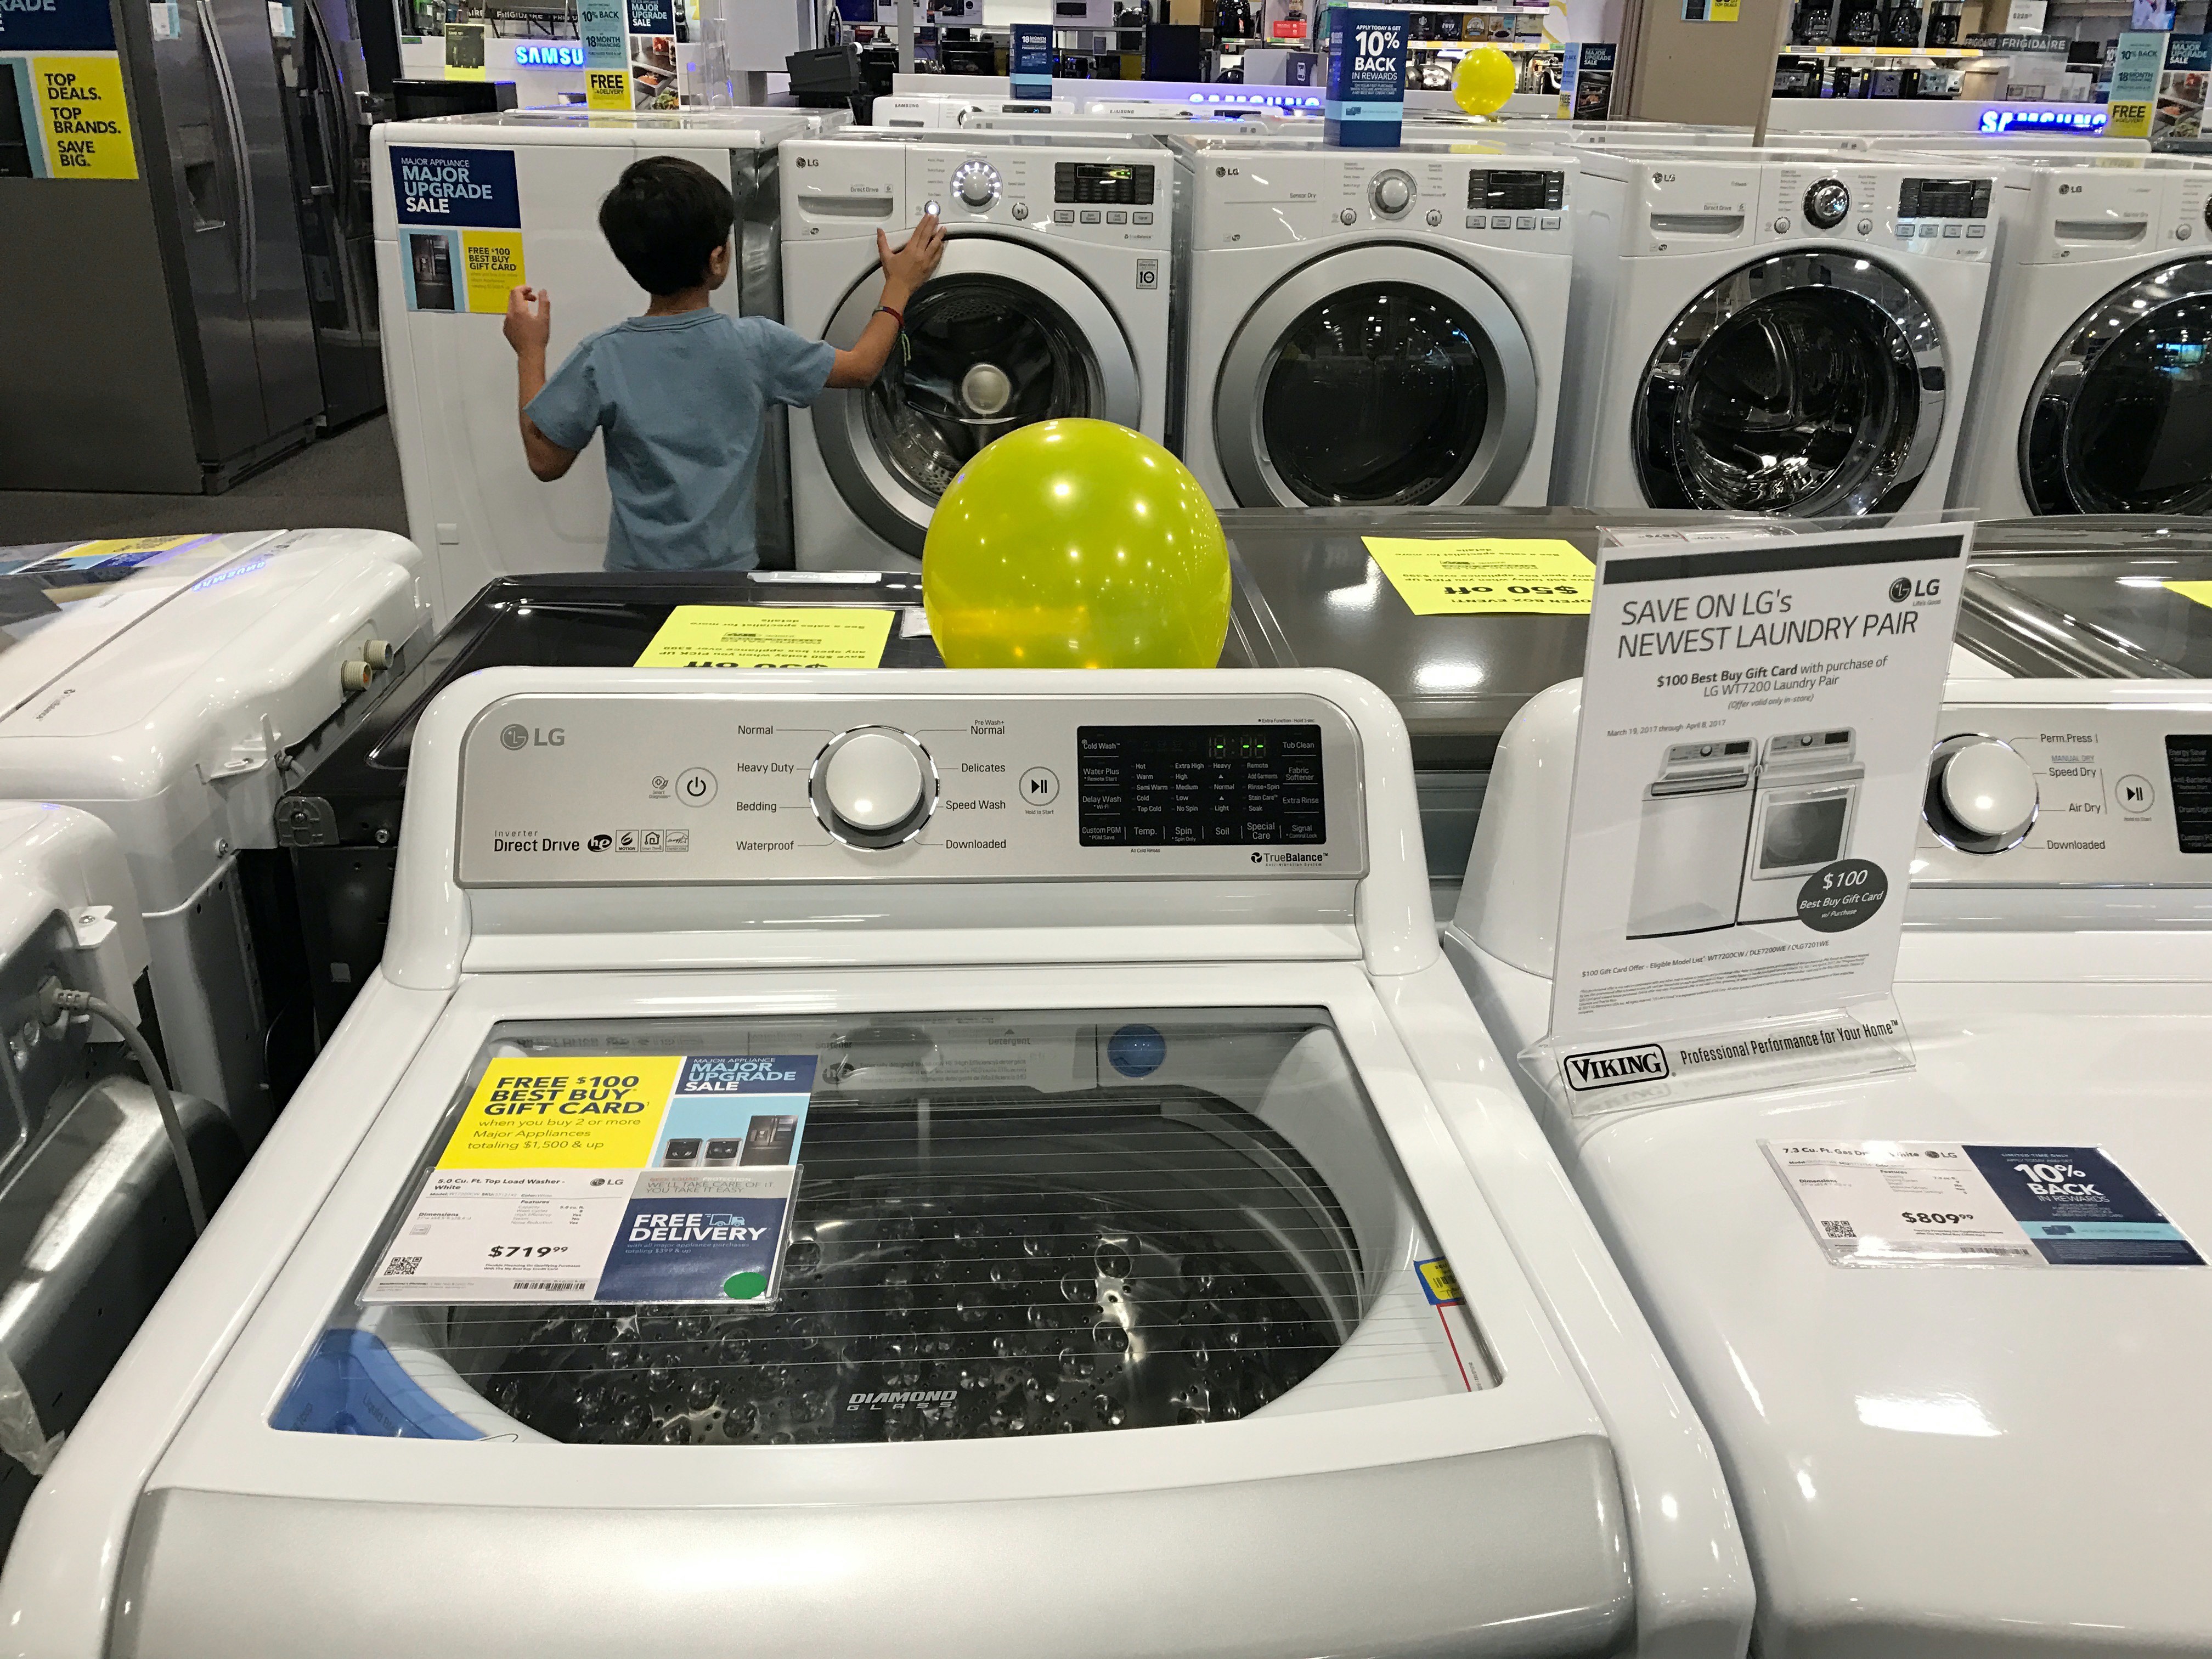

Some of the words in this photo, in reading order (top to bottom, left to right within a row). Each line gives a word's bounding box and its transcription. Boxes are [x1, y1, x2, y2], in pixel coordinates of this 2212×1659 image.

[631, 3, 658, 12] MAJOR
[582, 10, 598, 22] 10%
[599, 10, 619, 20] BACK
[631, 11, 667, 20] UPGRADE
[633, 18, 652, 27] SALE
[585, 36, 597, 48] 18
[1355, 31, 1400, 57] 10%
[2002, 38, 2066, 50] FRIGIDAIRE
[2172, 43, 2200, 52] MAJOR
[2171, 50, 2207, 59] UPGRADE
[1355, 57, 1396, 71] BACK
[44, 73, 76, 86] TOP
[590, 74, 624, 89] FREE
[1361, 72, 1397, 81] REWARDS
[48, 87, 101, 100] DEALS.
[50, 107, 82, 120] TOP
[2112, 105, 2146, 119] FREE
[53, 121, 121, 134] BRANDS.
[57, 140, 95, 154] SAVE
[59, 154, 91, 167] BIG.
[403, 166, 470, 183] MAJOR
[404, 182, 493, 200] UPGRADE
[406, 197, 450, 213] SALE
[1508, 586, 1578, 595] $50
[1915, 579, 1940, 597] LG
[1622, 597, 1690, 625] SAVE
[1696, 594, 1735, 619] ON
[1743, 589, 1792, 616] LG's
[1618, 627, 1732, 658] NEWEST
[1736, 616, 1859, 648] LAUNDRY
[1863, 611, 1918, 637] PAIR
[1657, 674, 1688, 688] $100
[1691, 673, 1718, 684] Best
[1720, 670, 1743, 683] Buy
[1746, 667, 1768, 679] Gift
[1771, 664, 1798, 677] Card
[1800, 662, 1824, 674] with
[1826, 659, 1873, 673] purchase
[1876, 656, 1888, 667] of
[1704, 686, 1718, 697] LG
[1722, 681, 1771, 695] WT7200
[1774, 676, 1817, 691] Laundry
[1819, 675, 1839, 686] Pair
[738, 725, 774, 735] Normal
[970, 725, 1005, 735] Normal
[534, 728, 565, 746] LG
[737, 763, 768, 774] Heavy
[771, 763, 794, 774] Duty
[962, 763, 1006, 772] Delicates
[2049, 768, 2078, 777] Speed
[2080, 768, 2096, 777] Dry
[736, 802, 777, 812] Bedding
[946, 800, 976, 811] Speed
[979, 800, 1006, 809] Wash
[2069, 803, 2081, 812] Air
[2084, 803, 2101, 814] Dry
[1134, 827, 1157, 835] Temp.
[1175, 827, 1192, 836] Spin
[1247, 822, 1275, 831] Special
[494, 839, 538, 852] Direct
[542, 838, 580, 852] Drive
[736, 840, 794, 852] Waterproof
[946, 839, 1006, 849] Downloaded
[2047, 840, 2106, 850] Downloaded
[1823, 870, 1868, 890] $100
[1799, 899, 1821, 910] Best
[1822, 897, 1841, 907] Buy
[1842, 894, 1860, 904] Gift
[1861, 890, 1884, 901] Card
[988, 1037, 1030, 1046] Detergent
[1570, 1051, 1662, 1083] VIKING
[1680, 1041, 1750, 1065] Professional
[1751, 1034, 1818, 1054] Performance
[1820, 1029, 1836, 1044] for
[1837, 1028, 1861, 1041] Your
[691, 1063, 772, 1072] MAJOR
[496, 1076, 569, 1088] FREE
[576, 1076, 640, 1088] $100
[689, 1071, 796, 1081] UPGRADE
[684, 1082, 739, 1091] SALE
[490, 1089, 565, 1102] BEST
[568, 1088, 633, 1101] BUY
[484, 1103, 555, 1115] GIFT
[547, 1119, 572, 1127] buy
[473, 1130, 512, 1138] Major
[515, 1130, 591, 1138] Appliances
[467, 1142, 519, 1150] totaling
[523, 1141, 568, 1149] $1,500
[2013, 1164, 2086, 1183] 10%
[2027, 1183, 2104, 1195] BACK
[634, 1214, 703, 1227] FREE
[629, 1228, 767, 1241] DELIVERY
[849, 1390, 957, 1404] DIAMOND
[847, 1402, 952, 1411] GLASS
